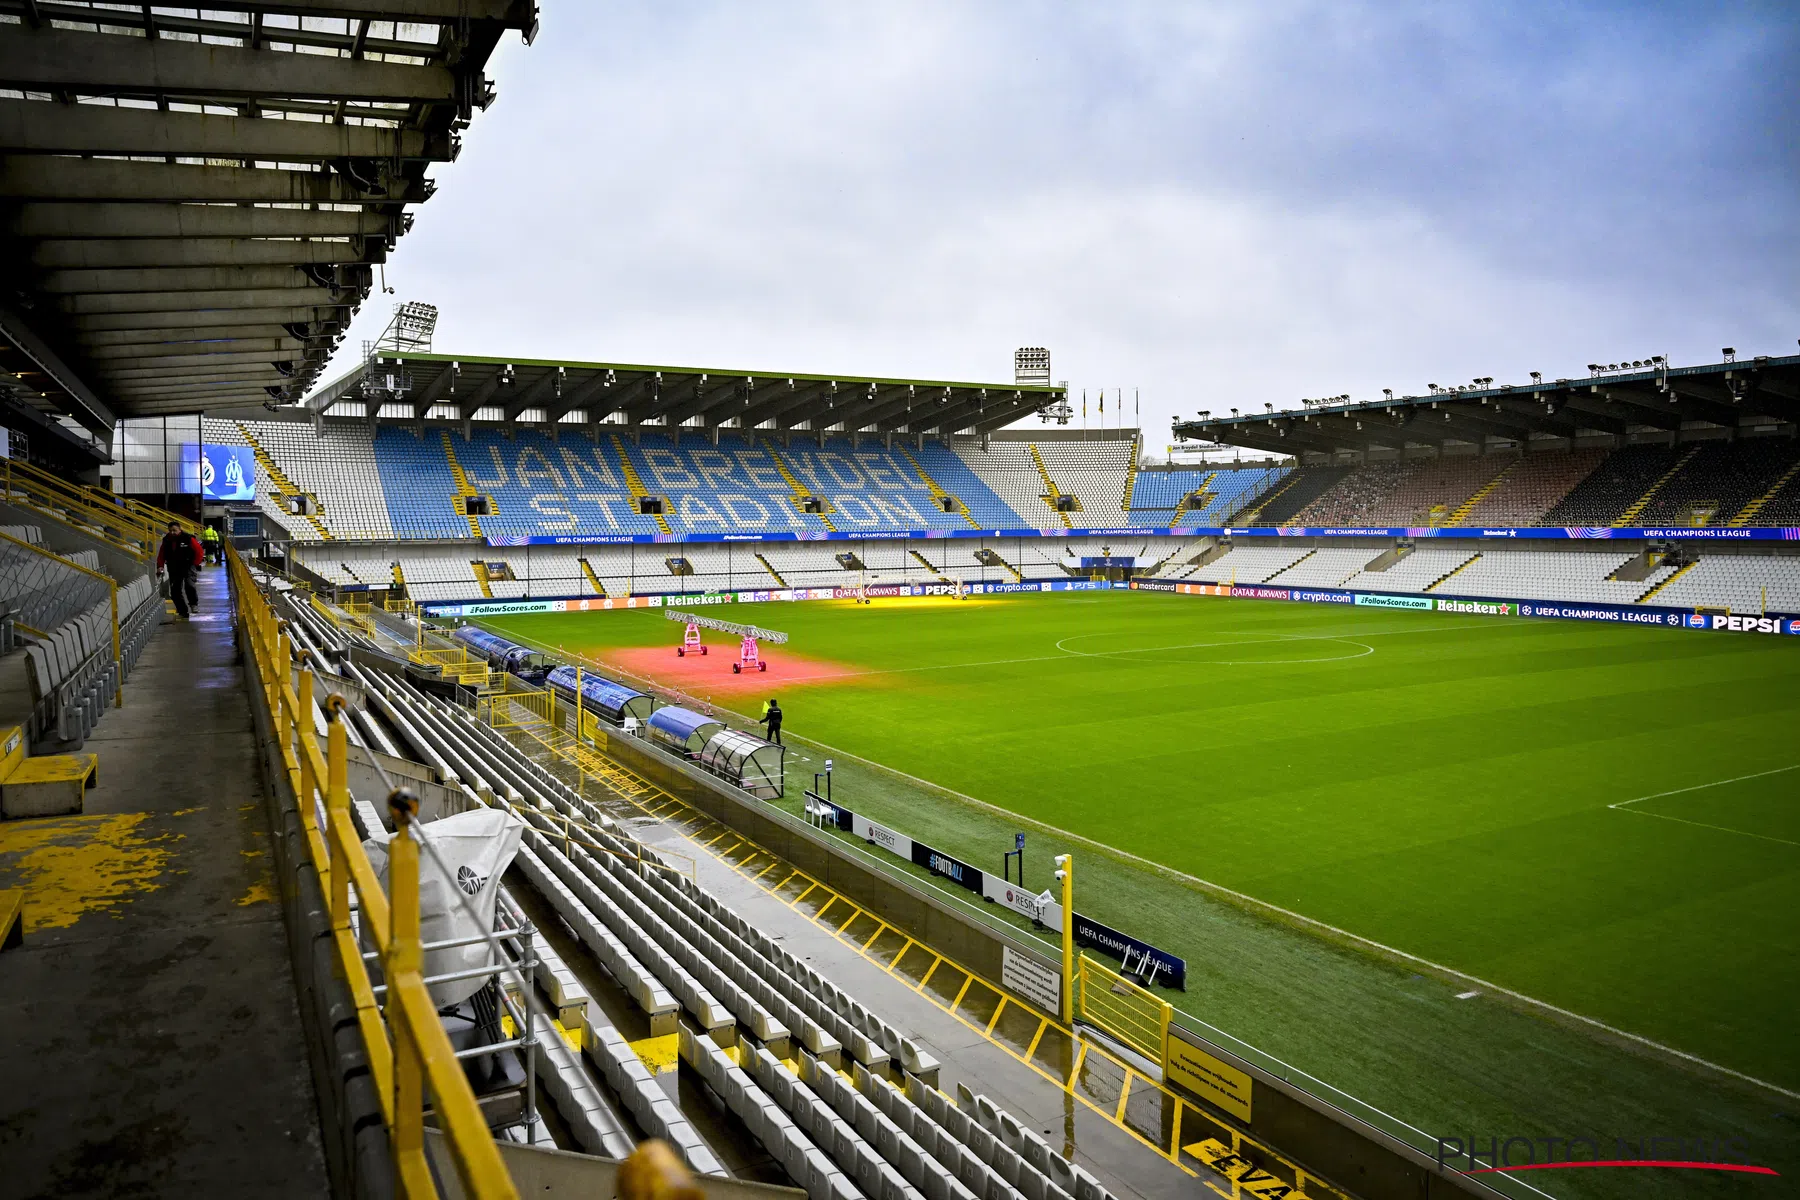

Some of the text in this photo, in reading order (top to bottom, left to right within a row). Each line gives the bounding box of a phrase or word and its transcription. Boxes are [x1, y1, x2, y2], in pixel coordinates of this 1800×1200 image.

[466, 445, 928, 490] JAN BREYDEL
[865, 587, 898, 596] AIRWAYS
[996, 583, 1038, 592] crypto.com
[1139, 582, 1175, 591] mastercard
[753, 591, 781, 601] FedEx
[1232, 588, 1287, 599] QATAR AIRWAYS
[1302, 592, 1351, 603] crypto.com
[667, 595, 723, 606] Heineken
[1437, 600, 1497, 614] Heineken
[1536, 607, 1662, 623] UEFA CHAMPIONS LEAGUE
[1712, 615, 1780, 634] PEPSI
[875, 829, 895, 846] RESPECT
[929, 853, 963, 881] #FOOTBALL
[1079, 925, 1098, 941] UEFA
[1098, 933, 1141, 960] CHAMPIONS
